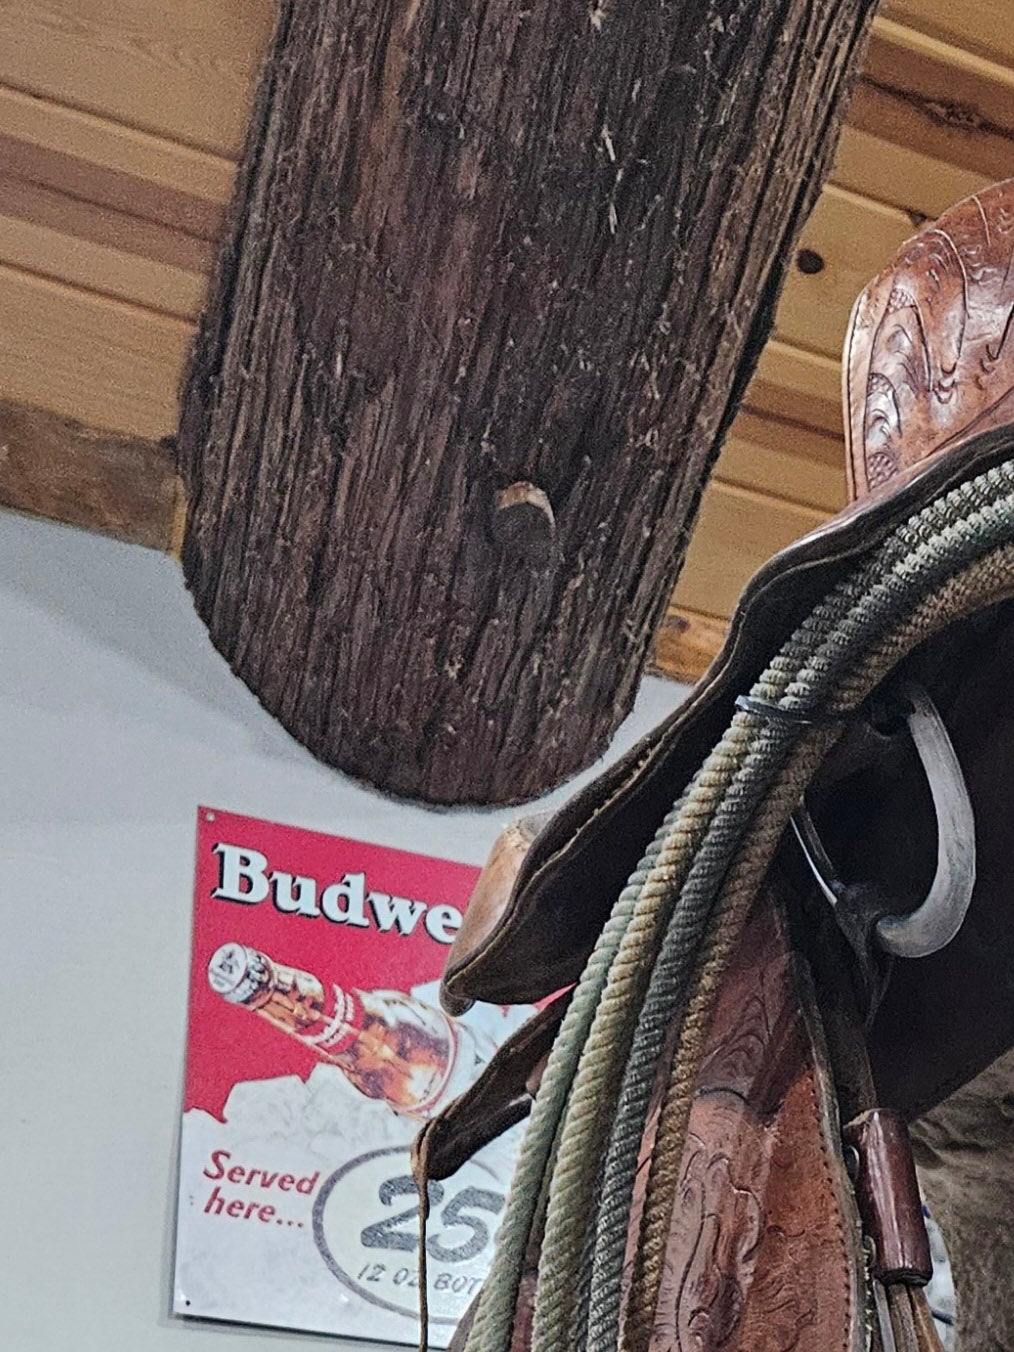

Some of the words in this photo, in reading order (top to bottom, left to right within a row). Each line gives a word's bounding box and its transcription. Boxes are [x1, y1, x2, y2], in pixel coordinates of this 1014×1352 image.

[203, 1150, 319, 1195] Served
[203, 1187, 305, 1229] here...
[360, 1175, 506, 1264] 25
[357, 1263, 386, 1282] 12
